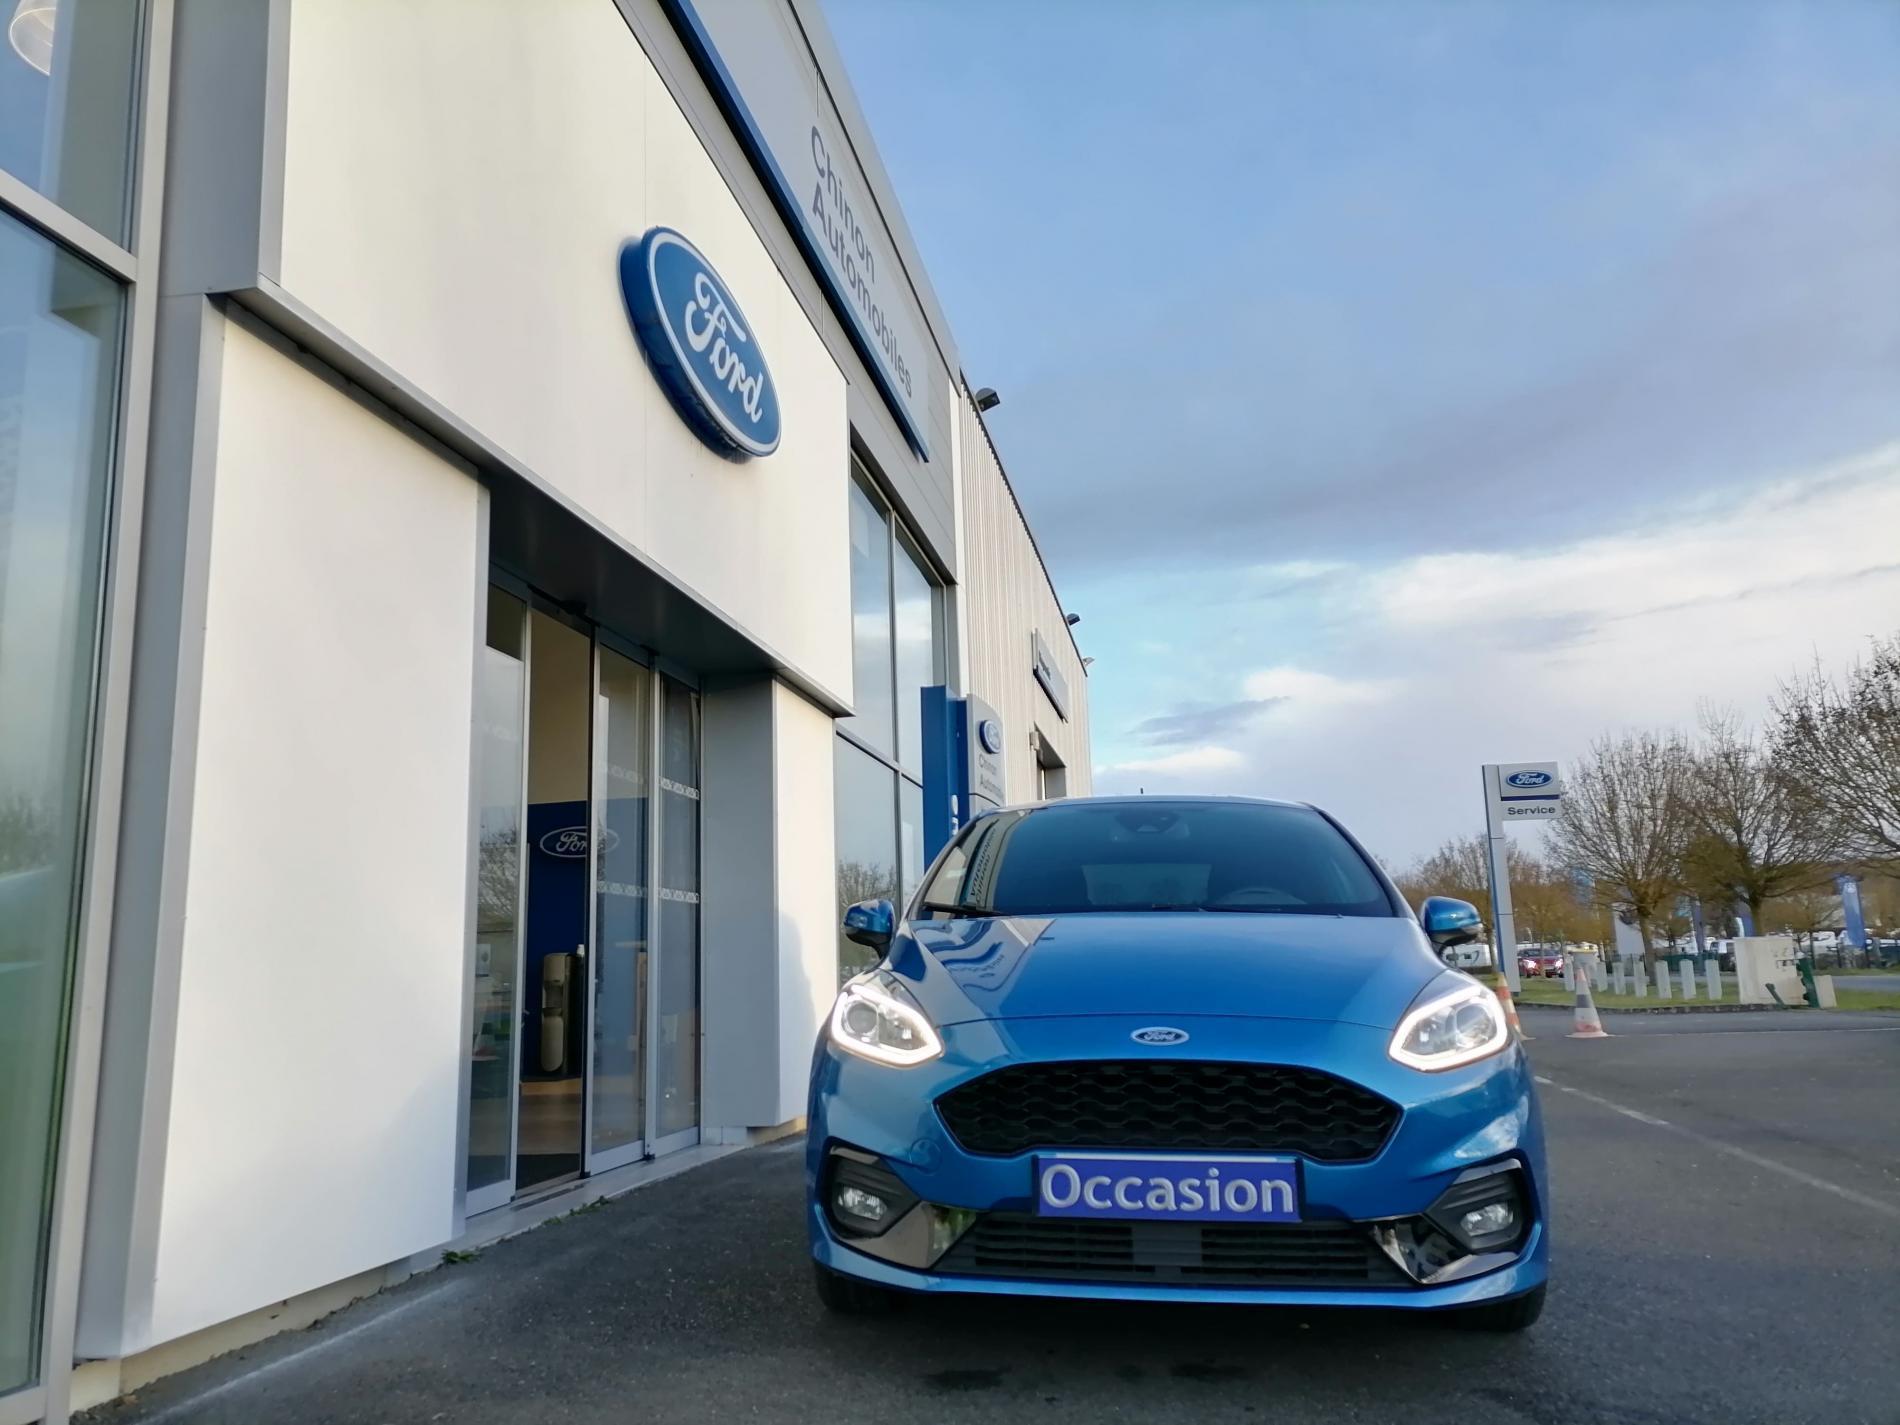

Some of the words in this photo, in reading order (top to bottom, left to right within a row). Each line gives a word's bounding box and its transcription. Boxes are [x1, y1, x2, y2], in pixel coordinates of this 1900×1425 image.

[811, 125, 875, 284] Chinon
[812, 181, 912, 398] Automobiles
[685, 271, 764, 424] Ford
[1516, 773, 1545, 785] Ford
[1507, 805, 1556, 816] Service
[555, 831, 594, 852] For
[1041, 1164, 1294, 1213] Occasion
